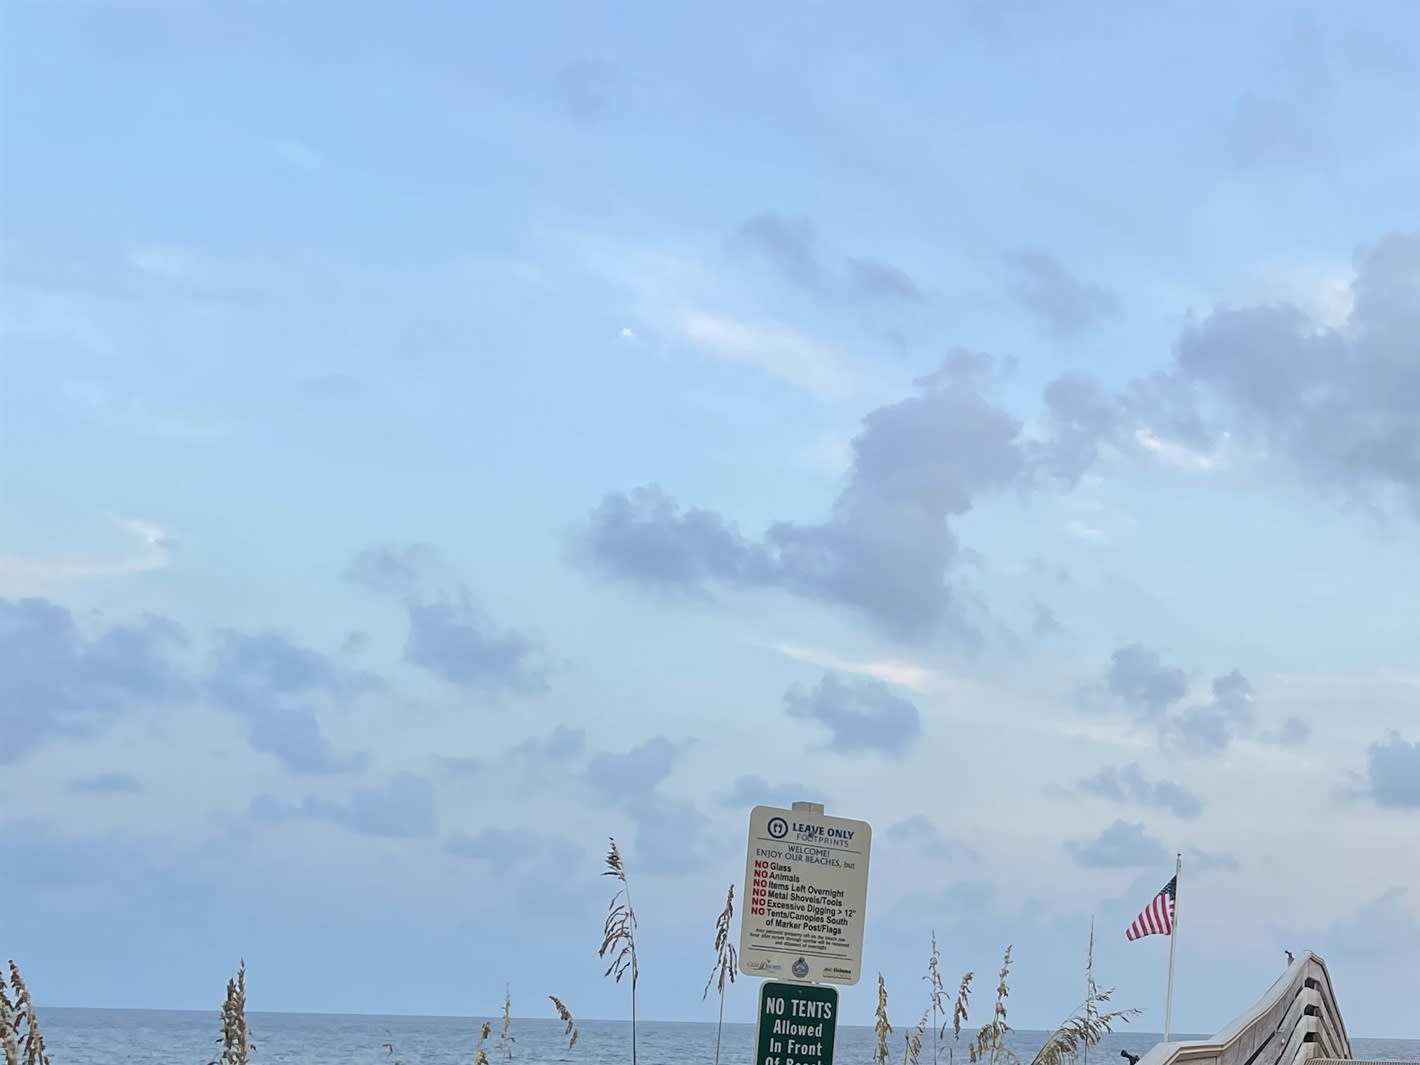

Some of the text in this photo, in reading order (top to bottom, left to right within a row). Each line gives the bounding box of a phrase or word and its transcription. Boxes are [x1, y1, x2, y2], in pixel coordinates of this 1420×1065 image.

[792, 822, 855, 840] LEAVE ONLY
[796, 833, 849, 847] FOOTPRINTS
[756, 848, 855, 870] ENJOY OUR BEACHES, but
[788, 845, 830, 857] WELCOME!
[754, 860, 792, 872] NO Glass
[753, 869, 800, 883] NO Animals
[752, 878, 844, 898] NO Items Left Overnight
[752, 888, 843, 907] NO Metal Shovels/Tools
[751, 897, 766, 906] NO
[767, 899, 805, 912] Excessive
[806, 904, 836, 917] Digging
[751, 907, 848, 926] NO Tents/Canopies South
[765, 918, 775, 926] of
[775, 919, 801, 930] Marker
[802, 923, 842, 936] Post/Flags
[766, 997, 832, 1020] NO TENTS
[772, 1019, 823, 1037] Allowed
[769, 1038, 823, 1057] In Front
